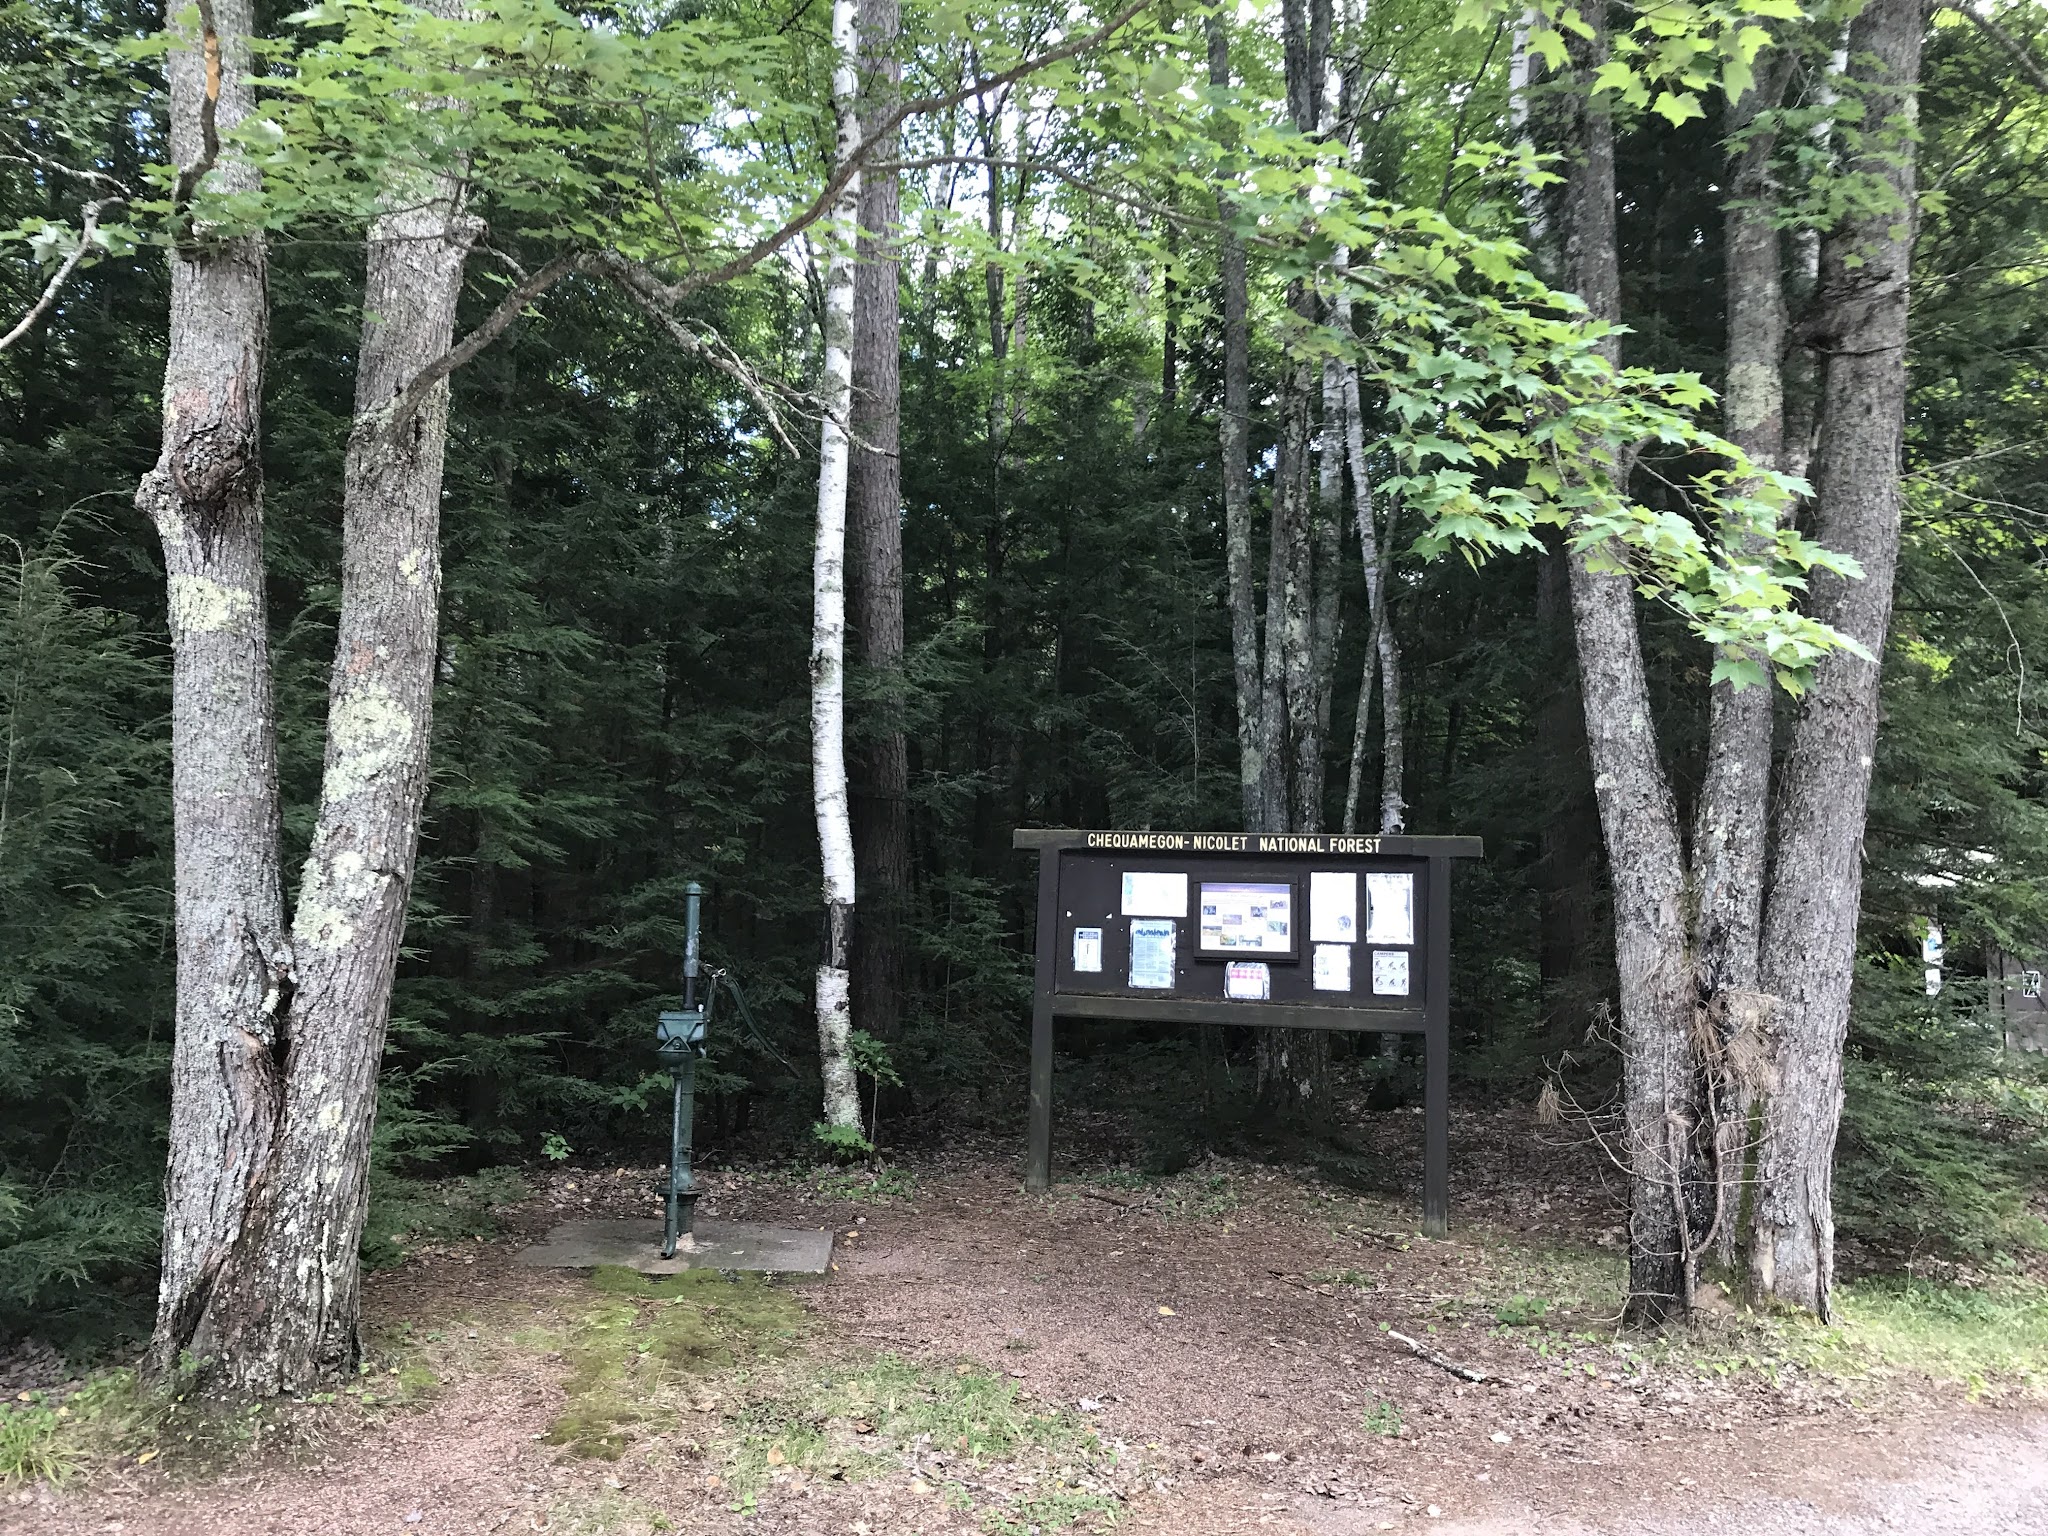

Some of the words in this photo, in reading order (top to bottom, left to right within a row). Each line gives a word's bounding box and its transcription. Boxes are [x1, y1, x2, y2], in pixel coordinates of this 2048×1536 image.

[1194, 835, 1248, 851] NICOLET
[1259, 836, 1325, 852] NATIONAL
[1329, 837, 1382, 854] FOREST
